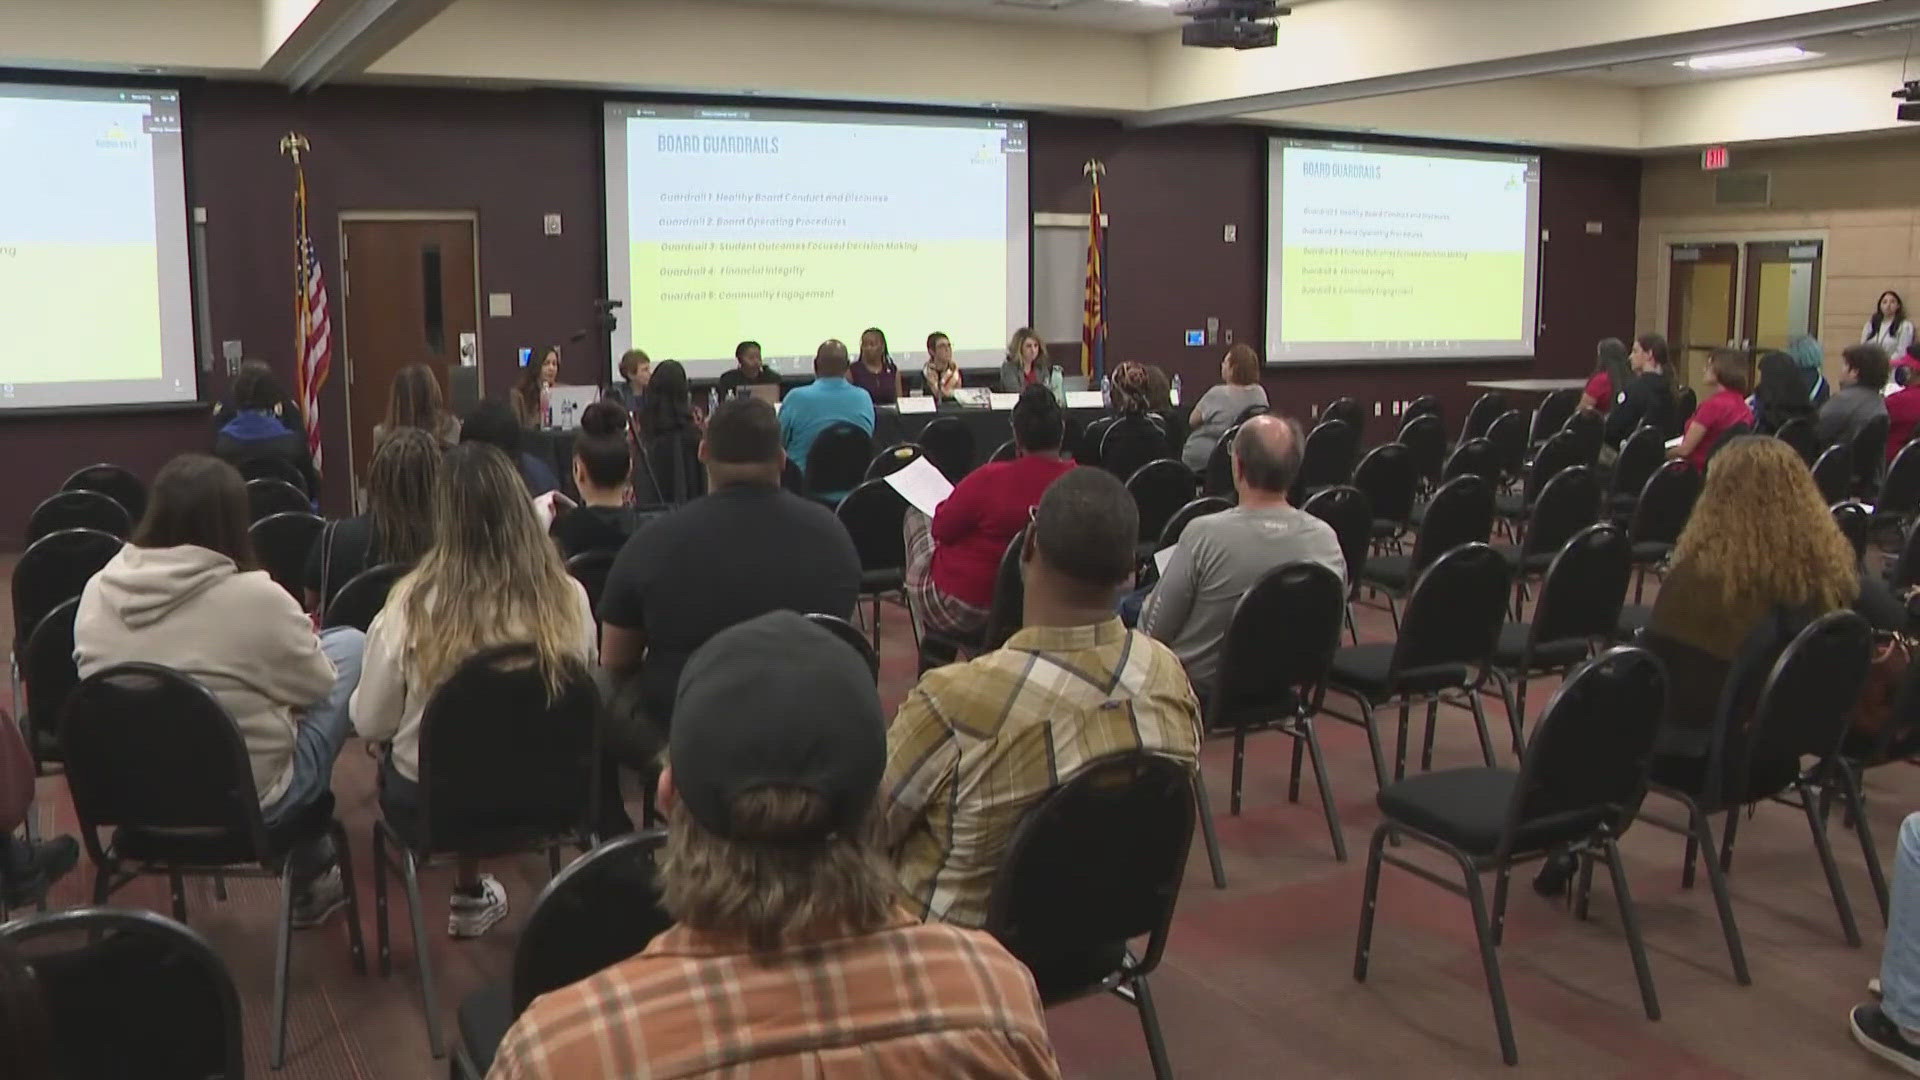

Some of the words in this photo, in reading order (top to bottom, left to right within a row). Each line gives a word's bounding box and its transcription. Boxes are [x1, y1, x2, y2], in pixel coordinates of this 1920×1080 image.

[658, 135, 700, 153] BOARD
[703, 135, 779, 154] GUARDRAILS
[1706, 148, 1726, 169] EXIT
[1303, 161, 1331, 178] BOARD
[1332, 163, 1381, 179] GUARDRAILS
[719, 242, 756, 251] Student
